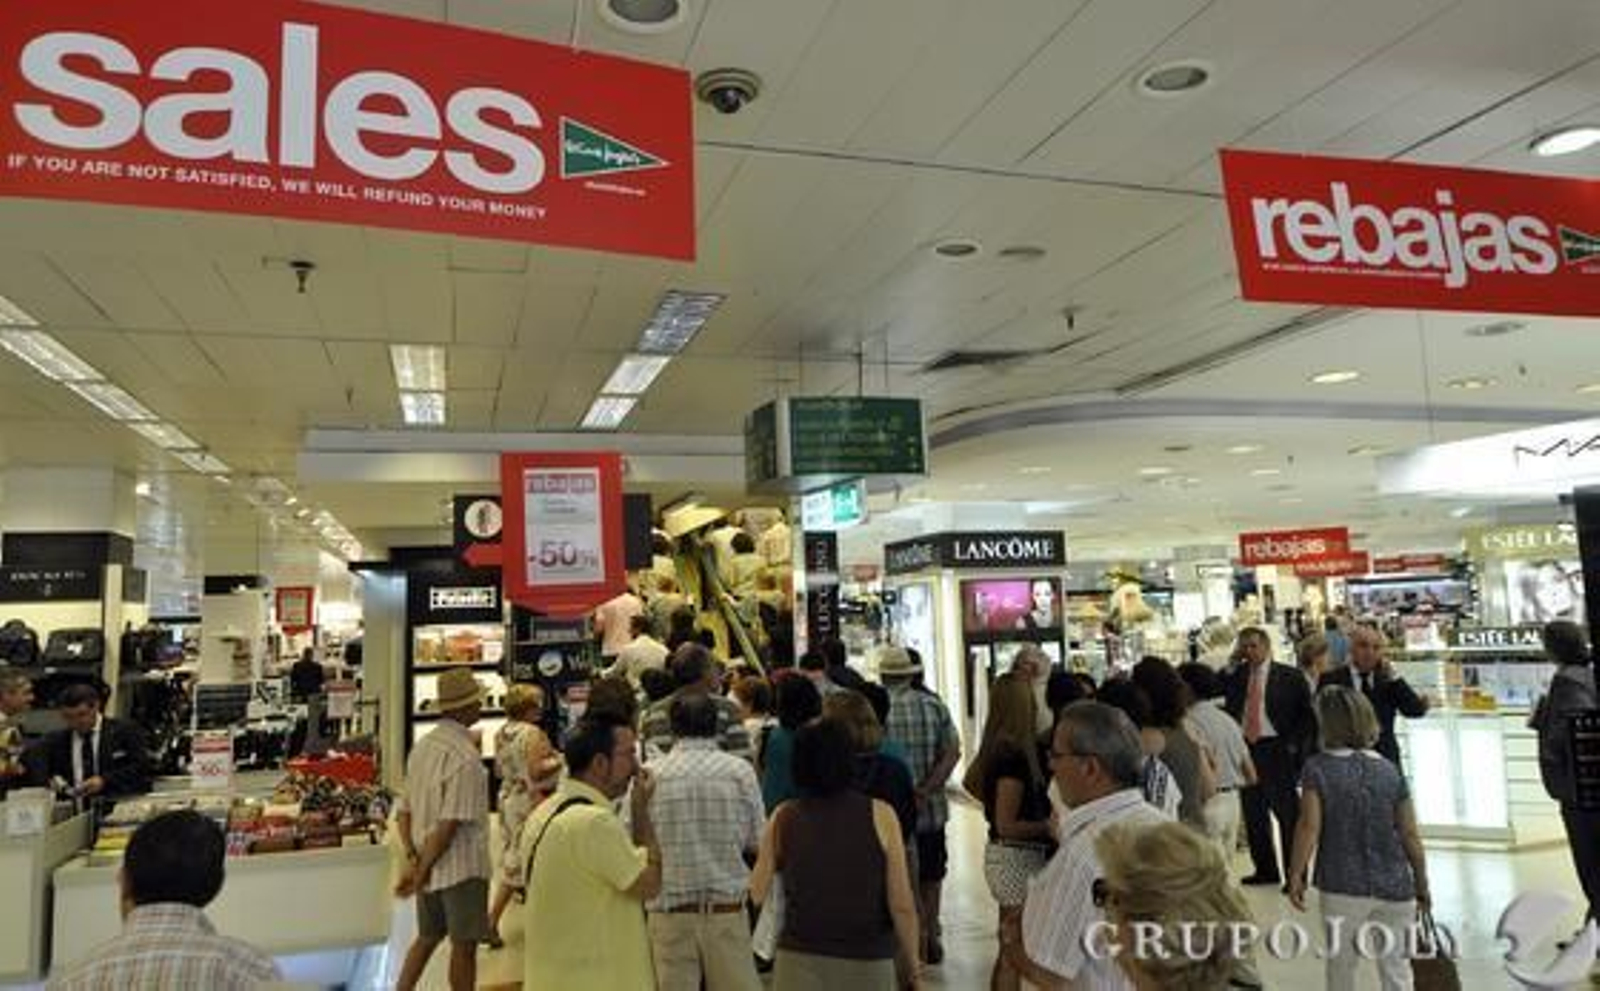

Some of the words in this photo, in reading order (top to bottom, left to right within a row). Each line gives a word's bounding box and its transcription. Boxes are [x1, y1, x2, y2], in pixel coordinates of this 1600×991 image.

[14, 22, 546, 194] sales
[7, 154, 28, 168] IF
[34, 156, 77, 172] YOU
[81, 161, 122, 177] ARE
[127, 165, 169, 180] NOT
[174, 168, 277, 191] SATISFIED,
[281, 177, 311, 193] WE
[315, 181, 357, 198] WILL
[363, 187, 434, 206] REFUND
[438, 196, 486, 212] YOUR
[490, 202, 546, 219] MONEY
[1252, 182, 1557, 288] rebajas
[953, 537, 1055, 560] LANCÔME
[1244, 532, 1326, 558] rebajas
